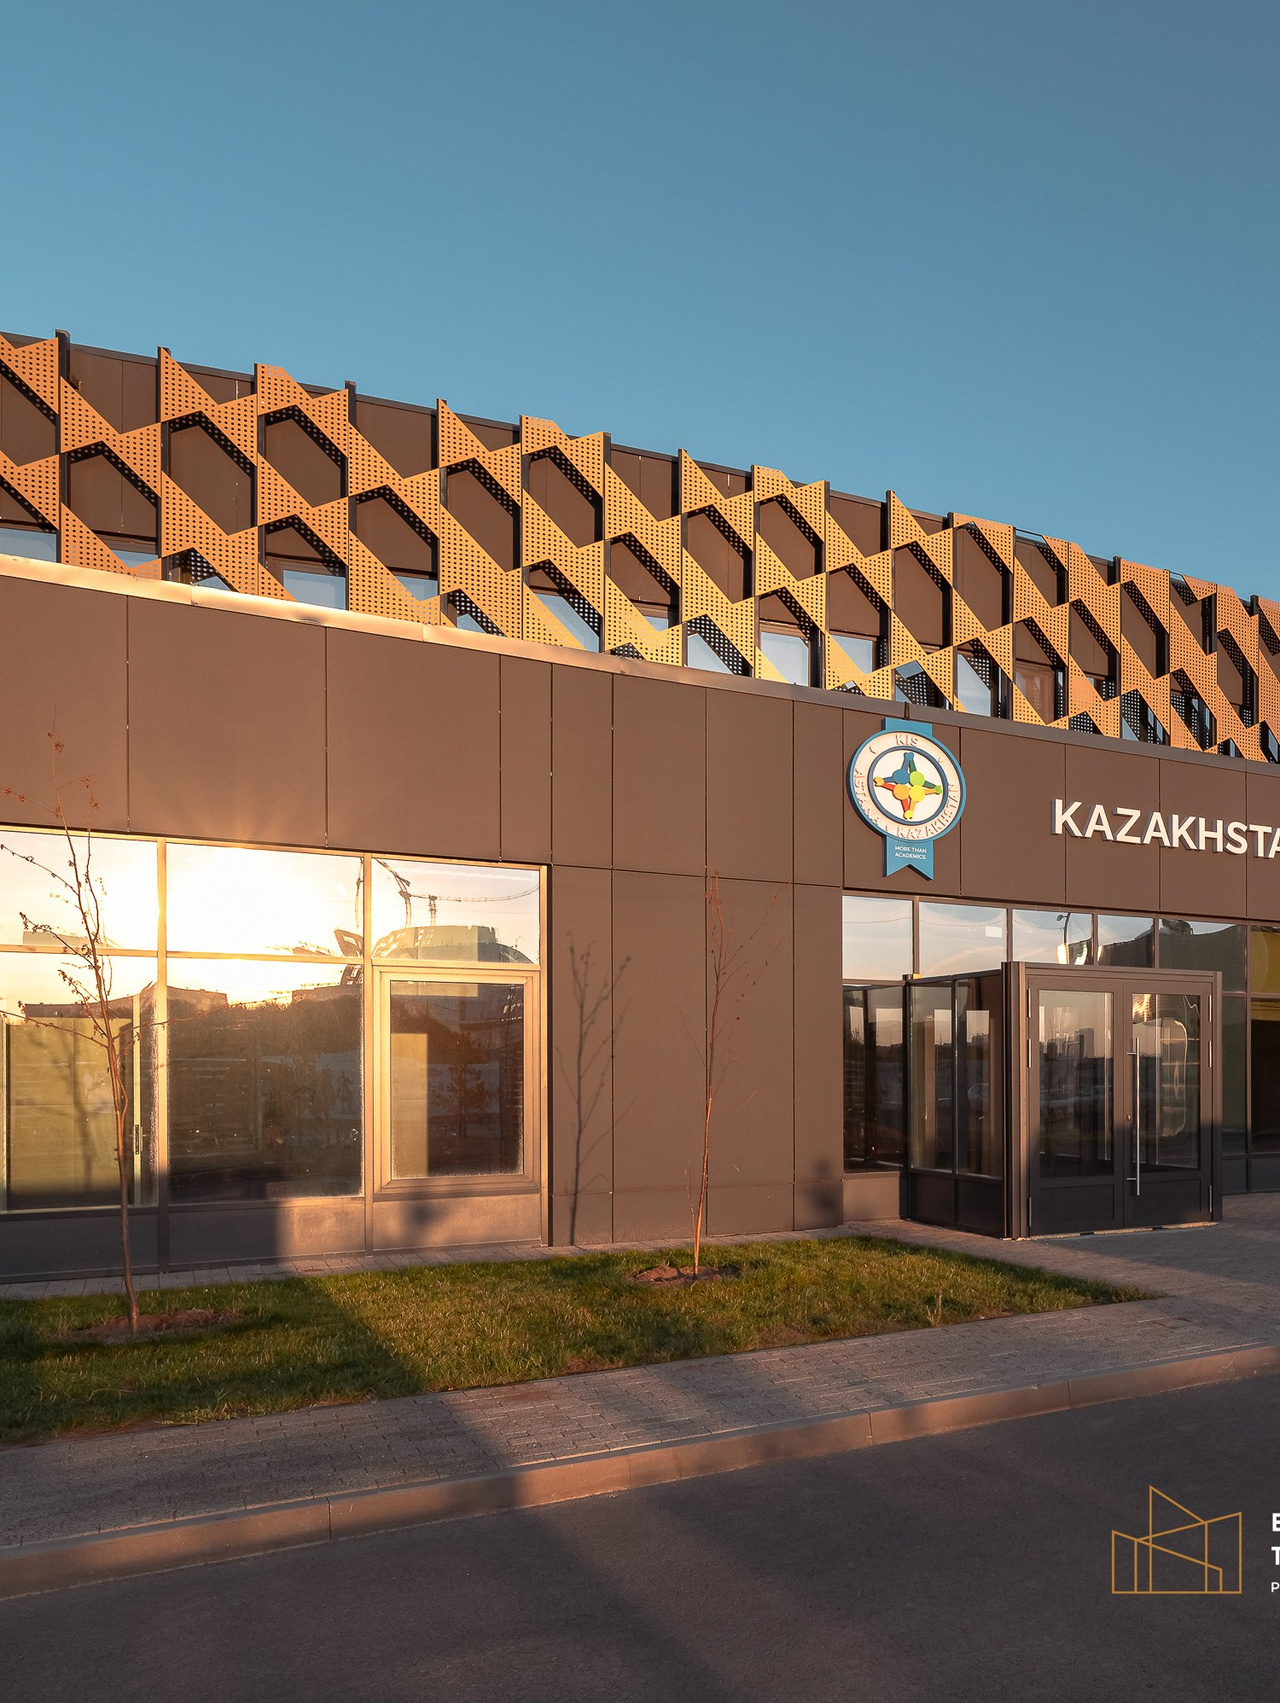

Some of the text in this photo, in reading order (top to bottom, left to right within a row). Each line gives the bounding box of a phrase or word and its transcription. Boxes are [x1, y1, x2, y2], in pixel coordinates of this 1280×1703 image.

[895, 733, 919, 748] KIS
[911, 846, 927, 854] THAN
[894, 852, 926, 860] ACADEMICS
